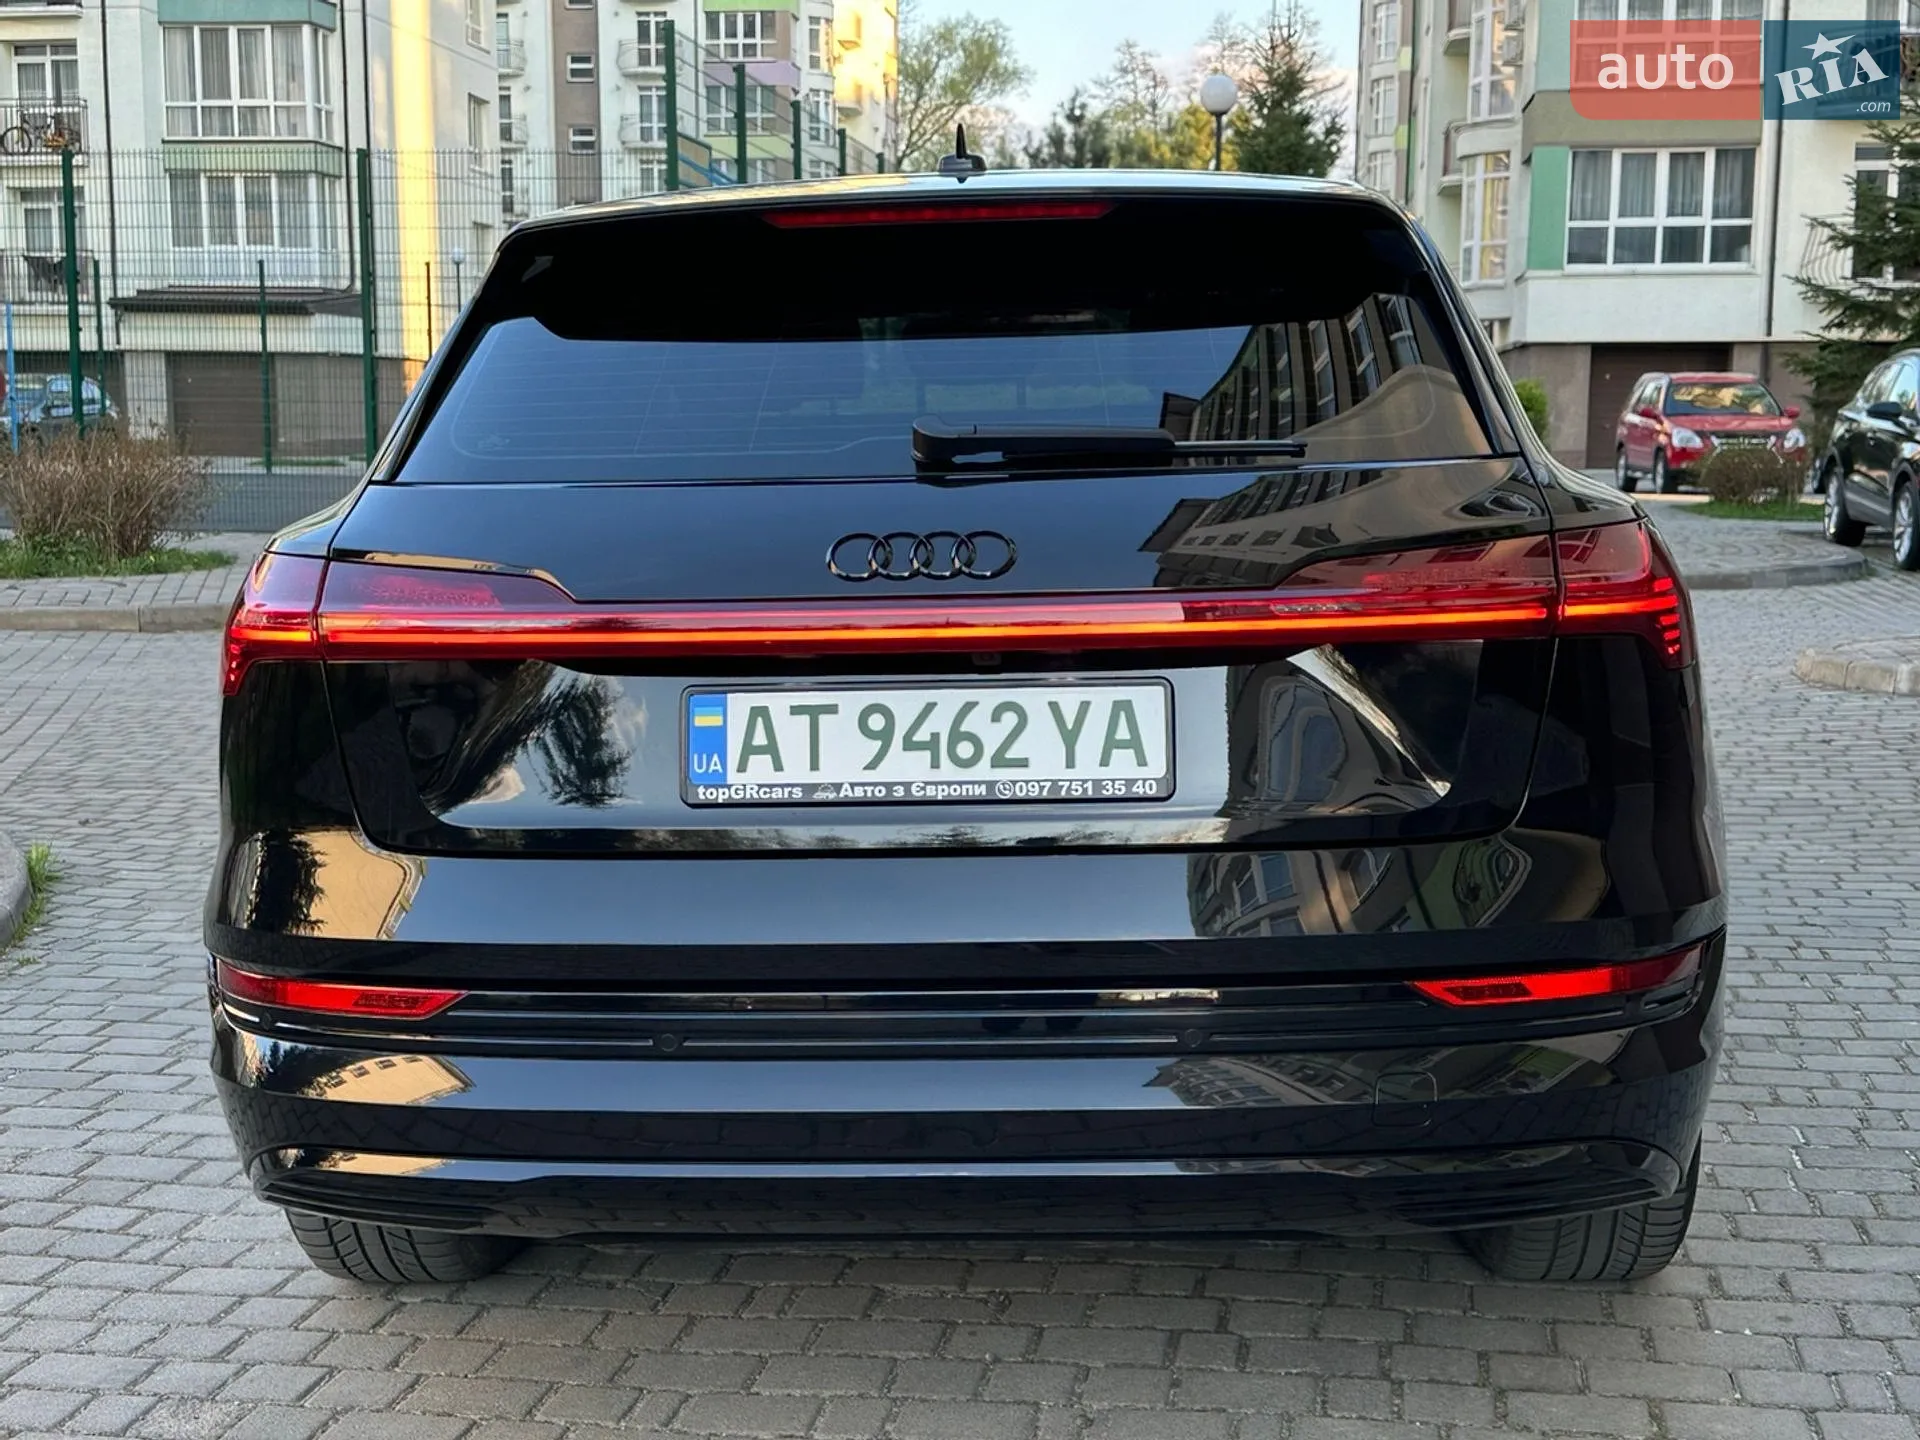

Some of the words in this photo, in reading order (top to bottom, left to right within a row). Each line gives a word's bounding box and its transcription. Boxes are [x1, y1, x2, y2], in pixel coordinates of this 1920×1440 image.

[736, 703, 839, 773] AT
[857, 701, 1030, 771] 9462
[1047, 699, 1148, 769] YA
[693, 753, 723, 774] UA
[697, 784, 803, 803] topGRcars
[839, 782, 887, 798] Авто
[892, 785, 905, 797] з
[911, 782, 987, 800] Європи
[1015, 781, 1052, 796] 097
[1058, 781, 1093, 796] 751
[1102, 780, 1126, 795] 35
[1132, 780, 1157, 795] 40
